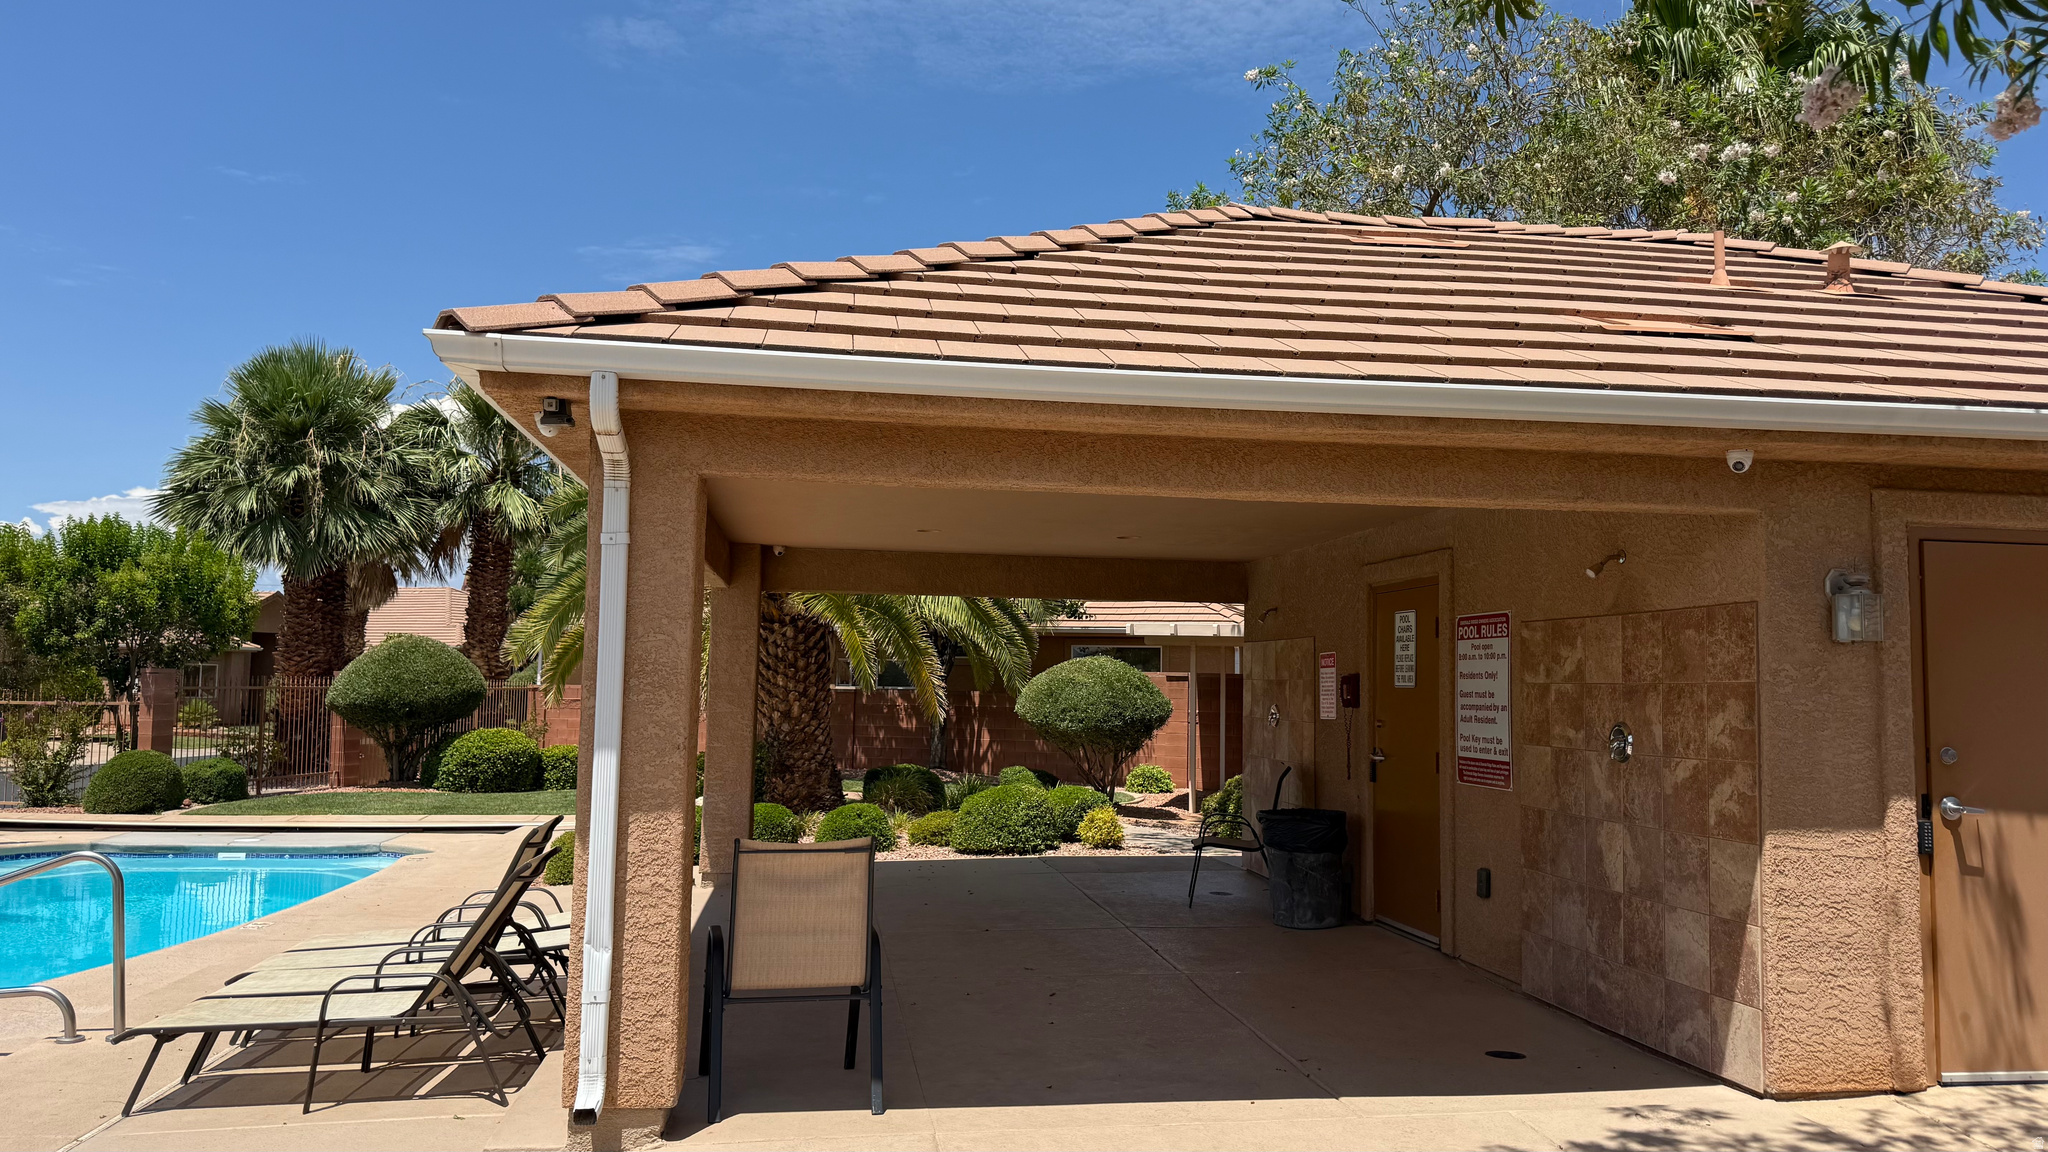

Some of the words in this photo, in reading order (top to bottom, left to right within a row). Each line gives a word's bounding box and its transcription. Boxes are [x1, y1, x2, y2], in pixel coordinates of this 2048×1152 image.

[1400, 615, 1410, 623] POOL
[1398, 625, 1412, 633] CHAIRS
[1458, 626, 1479, 639] POOL
[1481, 623, 1507, 637] RULES
[1484, 652, 1496, 660] 10:00
[1321, 658, 1334, 666] NOTICE
[1460, 671, 1483, 679] Residents
[1484, 671, 1498, 681] Only!
[1460, 690, 1473, 698] Guest
[1488, 690, 1494, 698] be
[1461, 703, 1492, 712] accompanied
[1493, 703, 1499, 713] by
[1460, 715, 1473, 723] Adult
[1474, 715, 1498, 724] Resident.
[1460, 734, 1470, 742] Pool
[1472, 734, 1481, 745] Key
[1496, 736, 1503, 745] be
[1473, 745, 1478, 753] to
[1479, 746, 1492, 754] enter
[1494, 747, 1497, 755] &
[1499, 748, 1508, 756] exit
